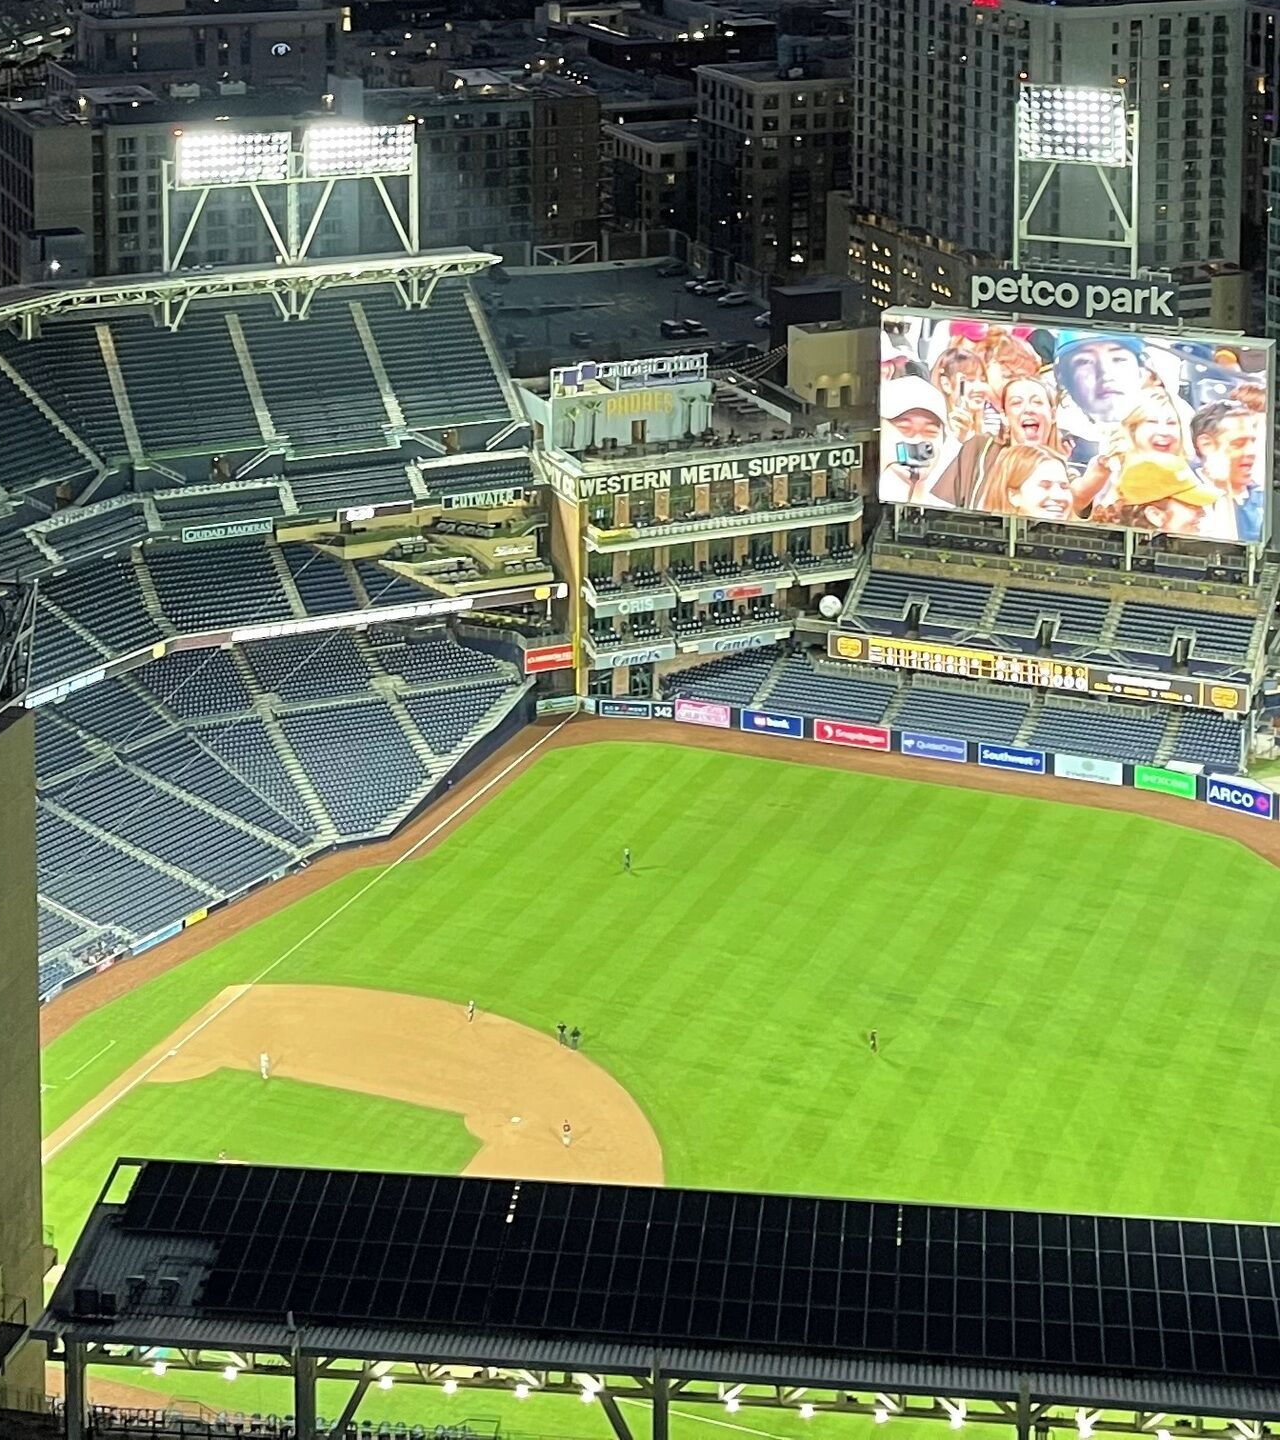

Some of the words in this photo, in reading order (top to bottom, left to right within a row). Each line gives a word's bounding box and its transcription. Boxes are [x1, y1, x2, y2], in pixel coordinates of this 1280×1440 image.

[971, 273, 1080, 309] petco
[1086, 285, 1175, 318] park
[580, 469, 671, 498] WESTERN
[680, 464, 744, 488] METAL
[748, 451, 821, 479] SUPPLY
[828, 448, 860, 467] CO.
[451, 490, 514, 508] CUTWATER
[654, 706, 673, 718] 342
[982, 749, 1034, 766] Southwest
[1209, 784, 1255, 809] ARCO
